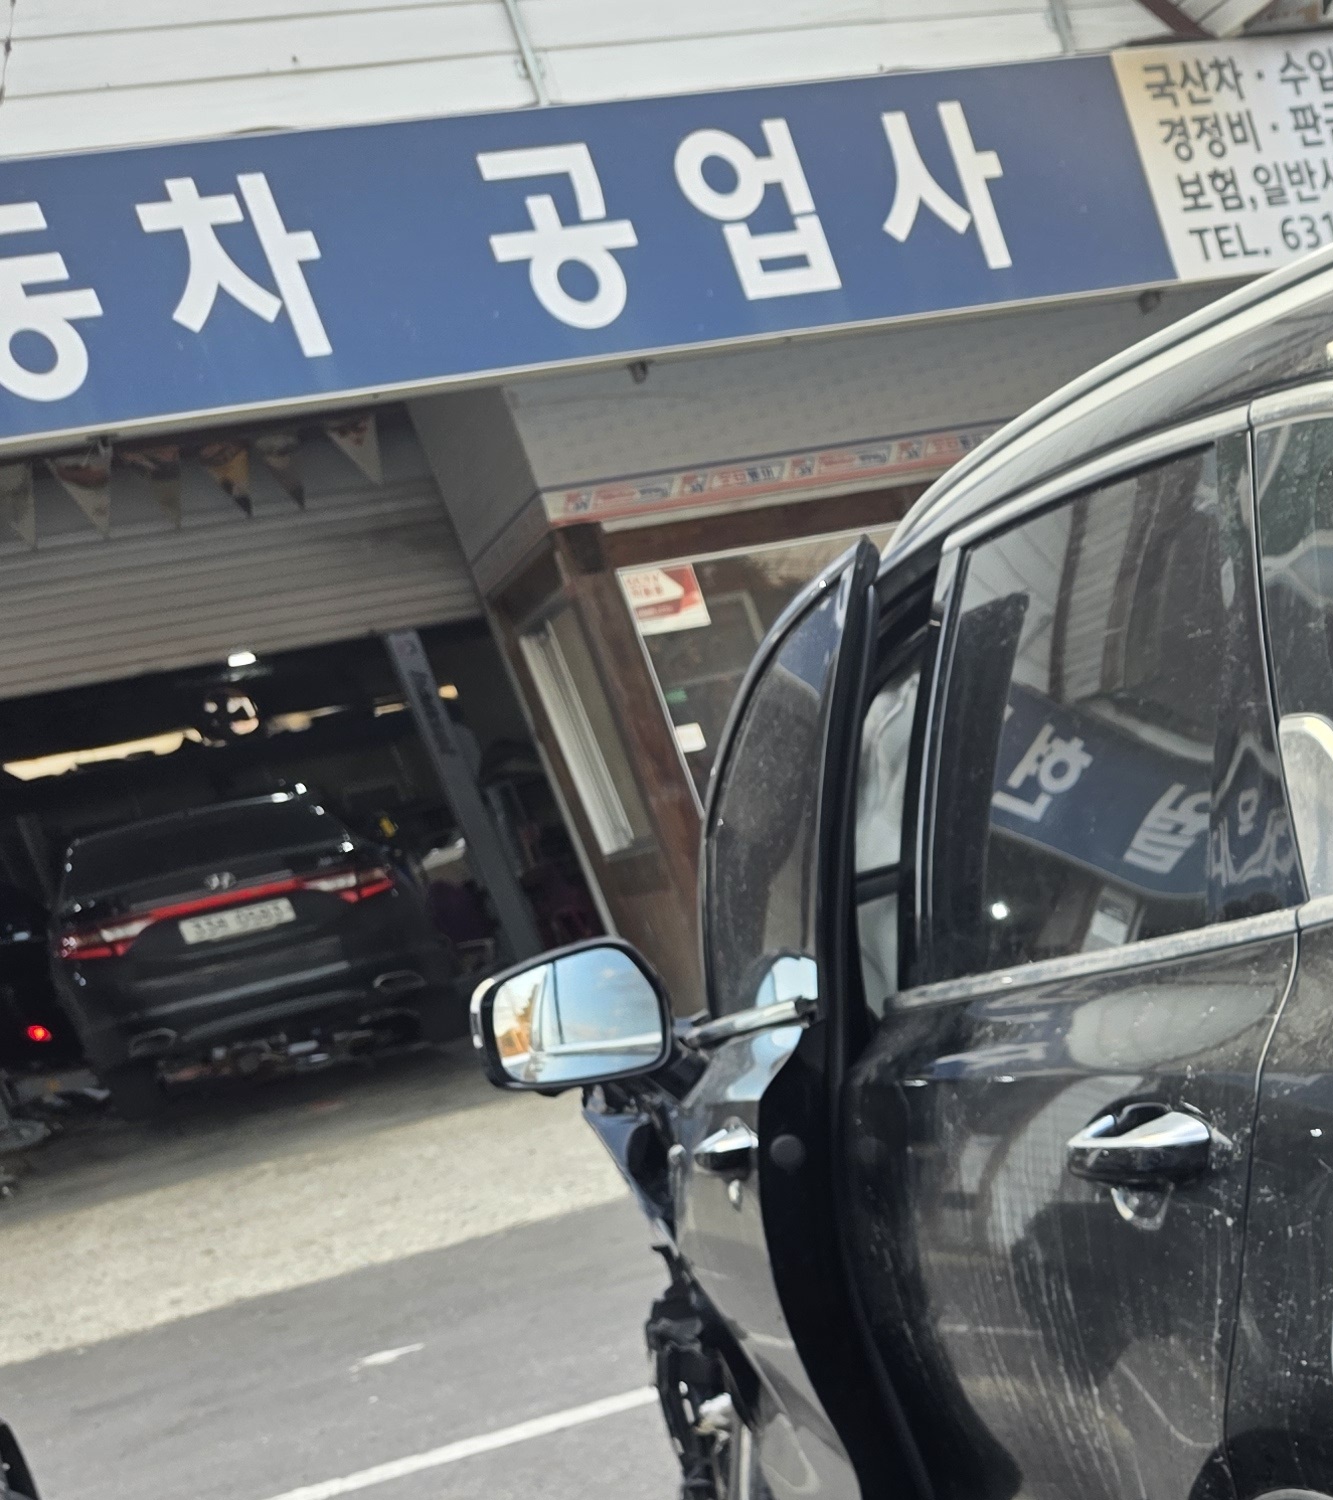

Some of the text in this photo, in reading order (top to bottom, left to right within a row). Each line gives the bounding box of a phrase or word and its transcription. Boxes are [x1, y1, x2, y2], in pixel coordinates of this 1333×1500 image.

[1143, 55, 1246, 106] 국산차
[1159, 109, 1262, 162] 경정비
[476, 100, 1013, 330] 공업사
[1189, 222, 1271, 262] TEL.
